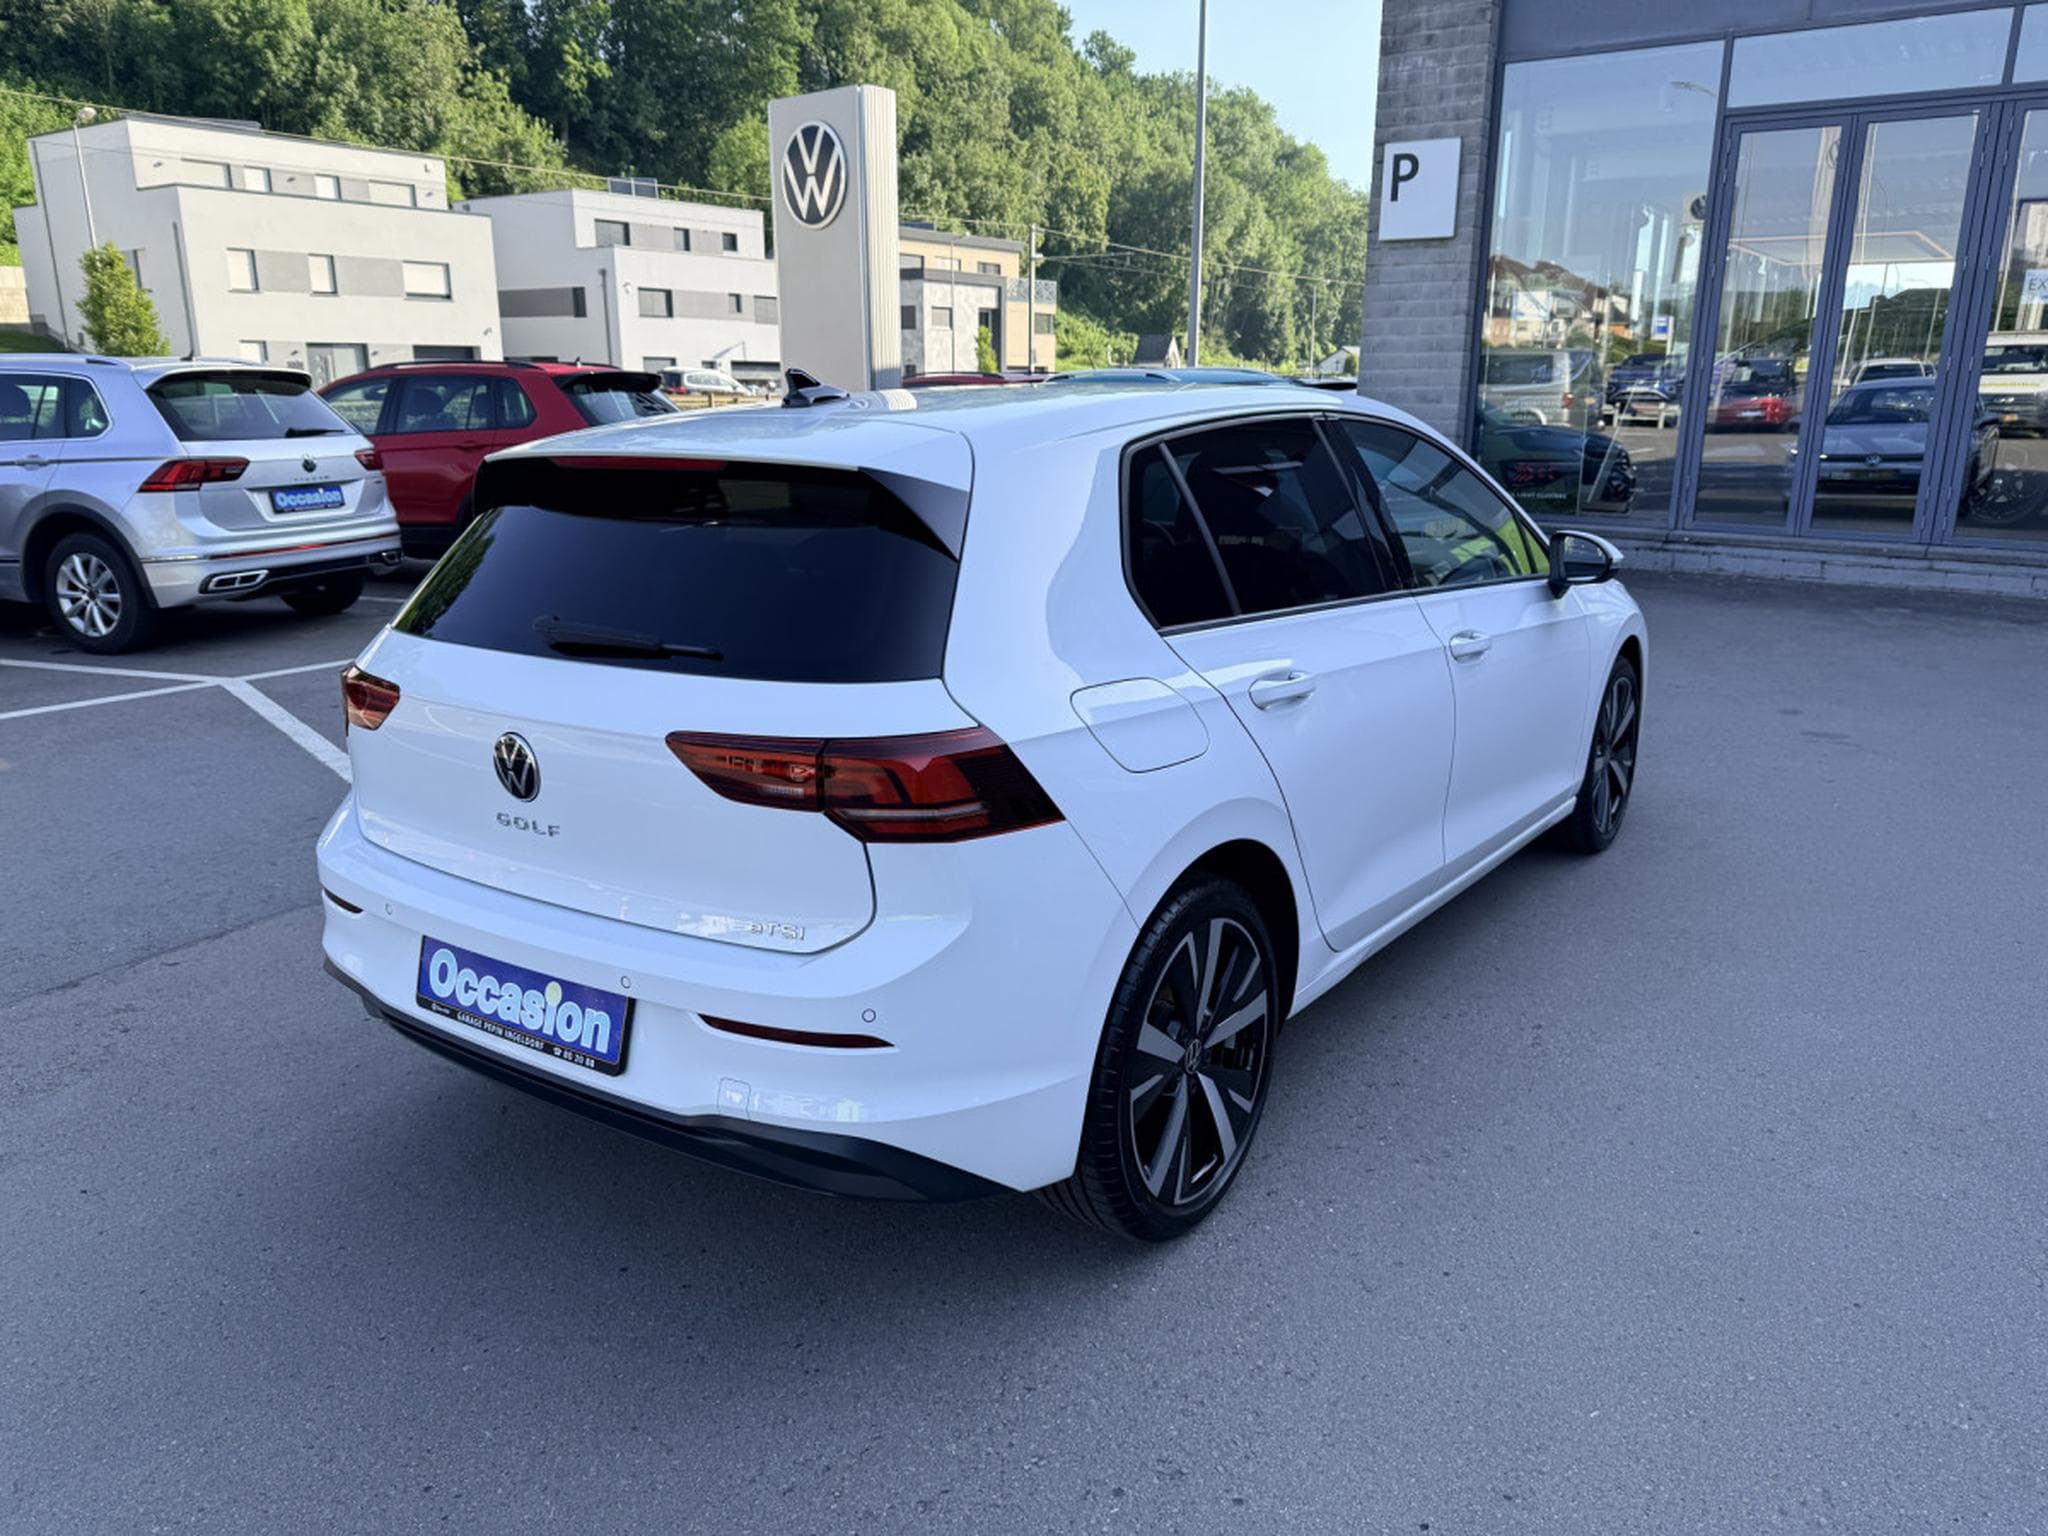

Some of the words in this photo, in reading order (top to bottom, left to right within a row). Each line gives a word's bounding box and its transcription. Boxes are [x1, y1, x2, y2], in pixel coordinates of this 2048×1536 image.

[783, 121, 847, 229] VW
[1390, 153, 1420, 202] P
[276, 488, 341, 507] Occasion
[496, 812, 560, 837] GOLF
[429, 948, 611, 1054] Occasion
